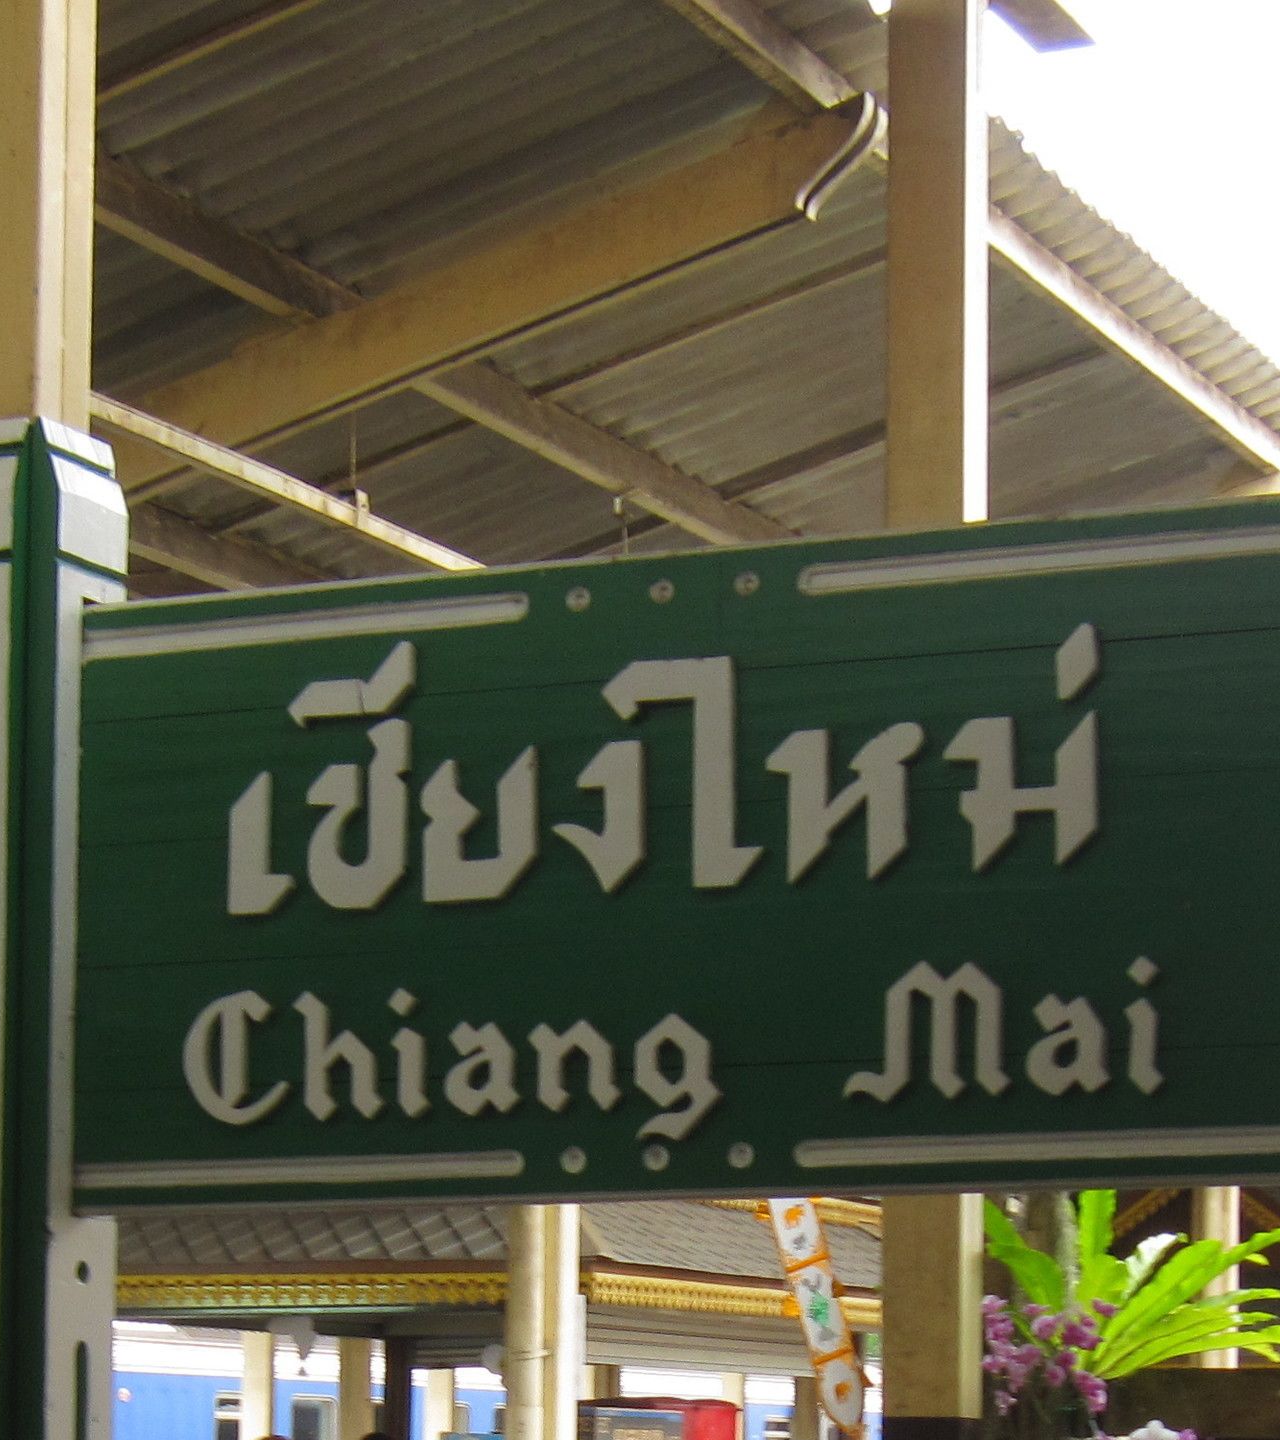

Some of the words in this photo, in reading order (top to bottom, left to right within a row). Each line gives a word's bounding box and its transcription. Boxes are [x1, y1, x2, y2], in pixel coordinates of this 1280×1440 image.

[226, 622, 1101, 916] เชียงใหม่
[182, 988, 722, 1142] Chiang
[841, 955, 1164, 1102] Mai
